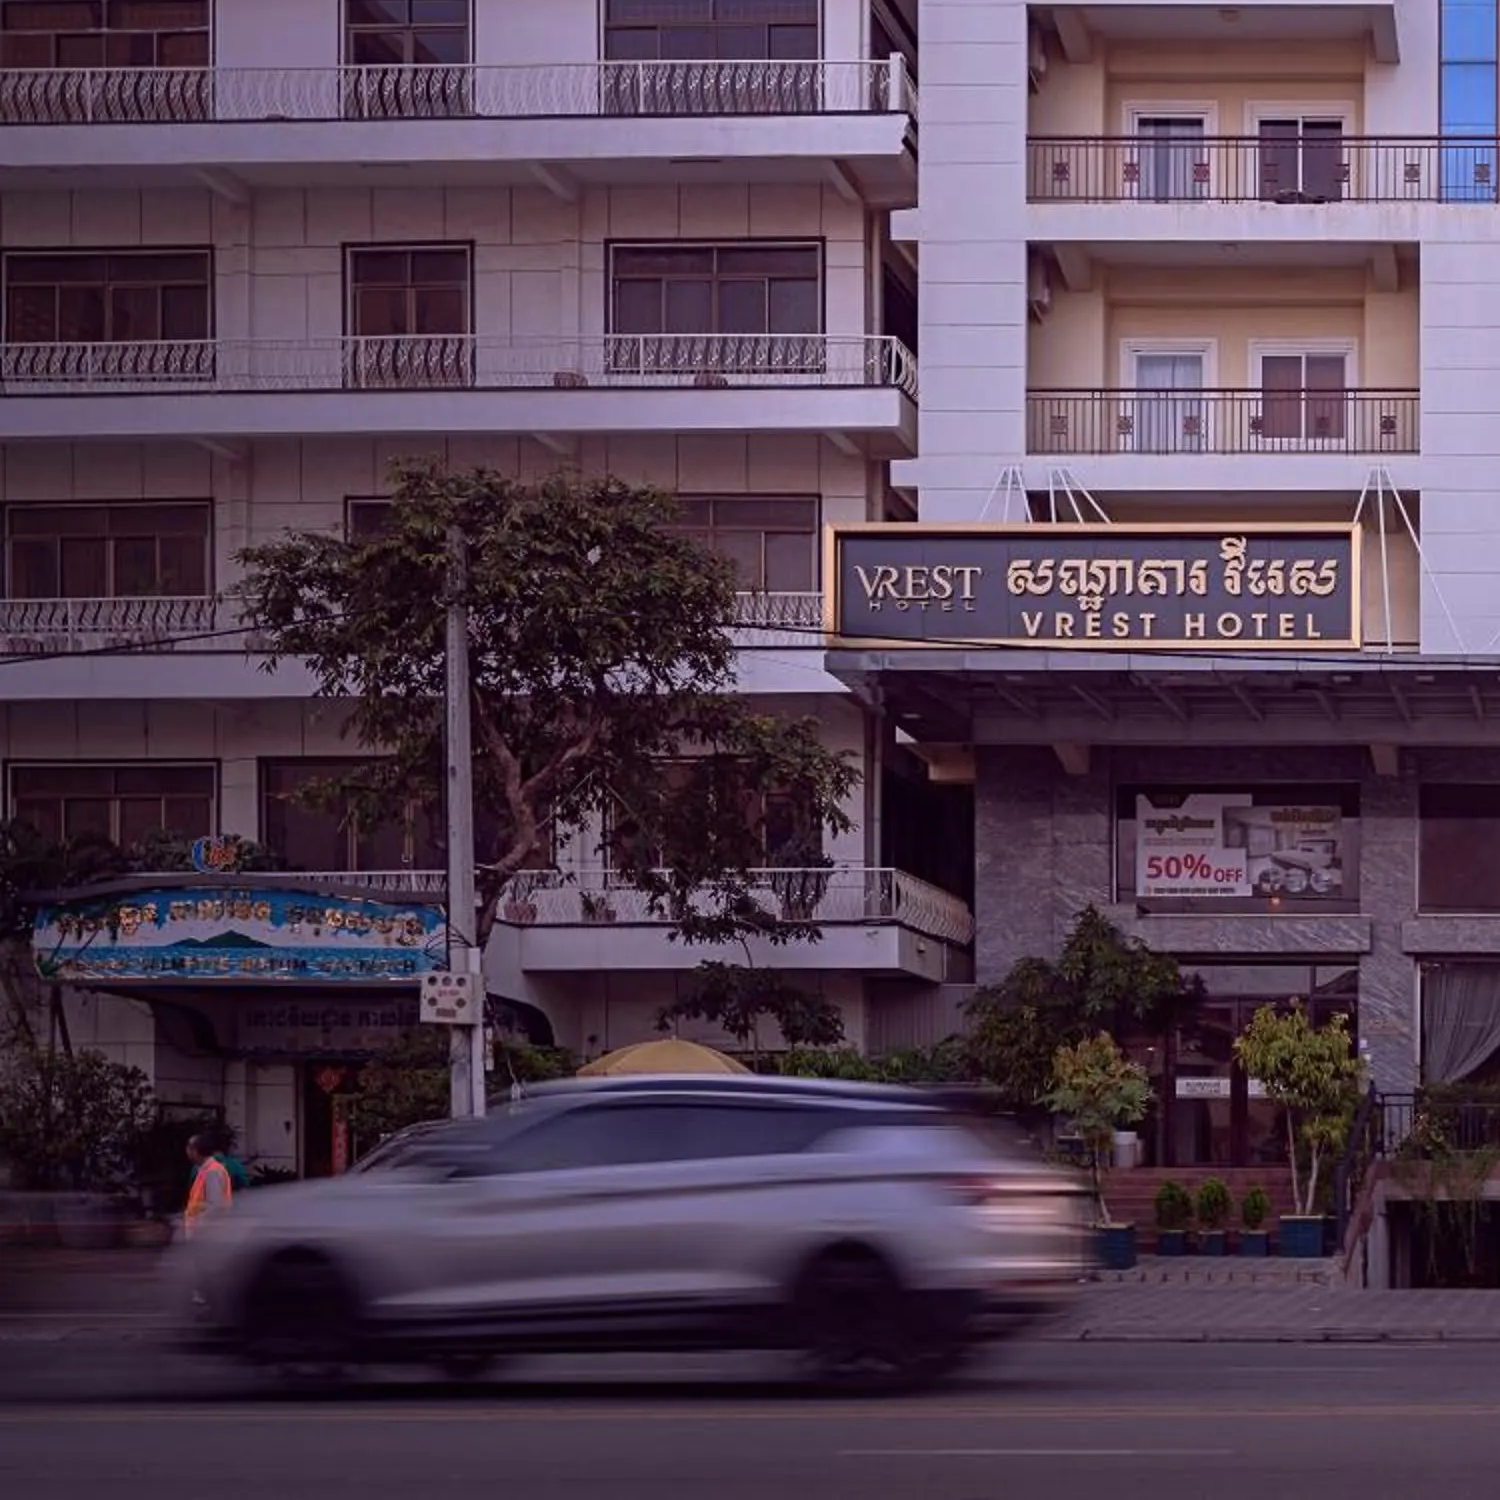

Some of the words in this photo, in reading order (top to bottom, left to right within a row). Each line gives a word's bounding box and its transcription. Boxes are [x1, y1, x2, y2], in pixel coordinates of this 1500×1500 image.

[852, 564, 983, 599] VREST
[868, 599, 977, 612] HOTEL
[1020, 611, 1159, 638] VREST
[1184, 611, 1323, 638] HOTEL
[1146, 853, 1212, 880] 50%
[1213, 867, 1244, 883] OFF
